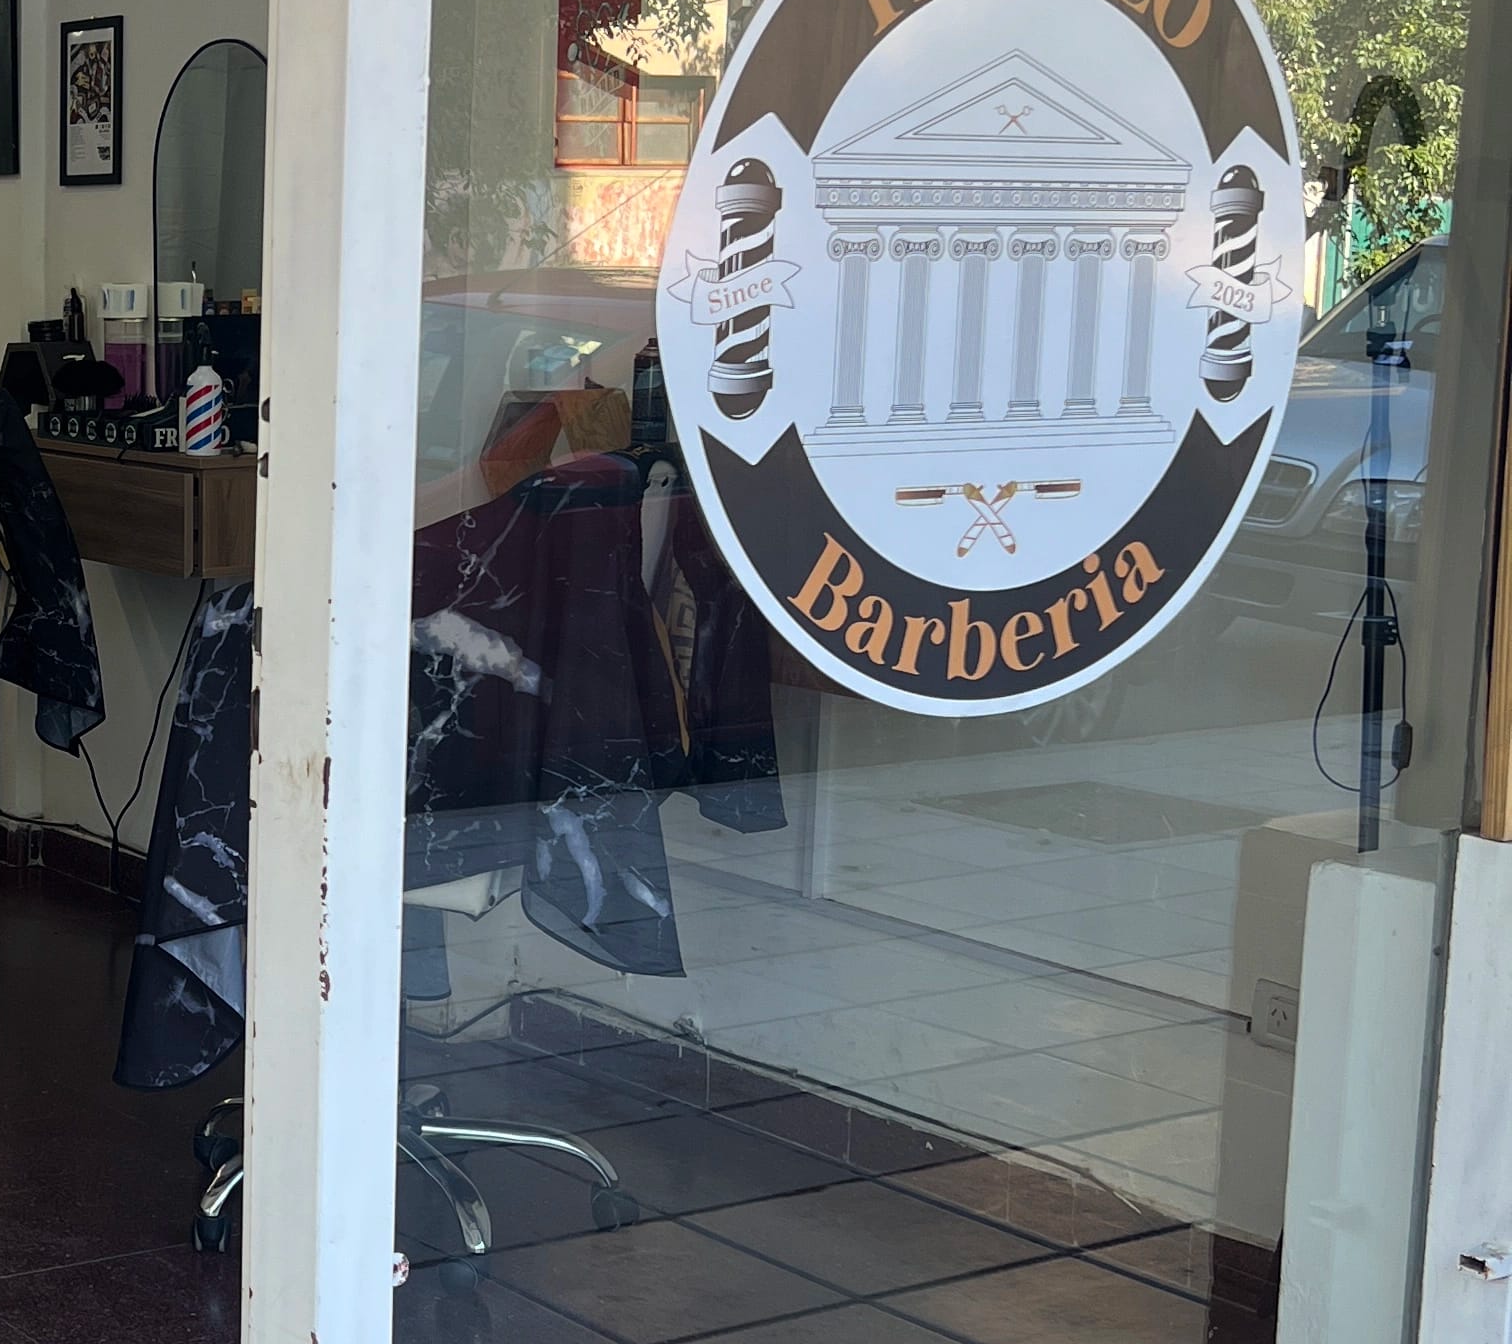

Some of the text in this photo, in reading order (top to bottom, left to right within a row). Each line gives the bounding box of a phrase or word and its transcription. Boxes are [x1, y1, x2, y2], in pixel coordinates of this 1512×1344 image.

[706, 276, 774, 315] Since
[1210, 280, 1256, 313] 2023
[786, 531, 1167, 682] Barberia
